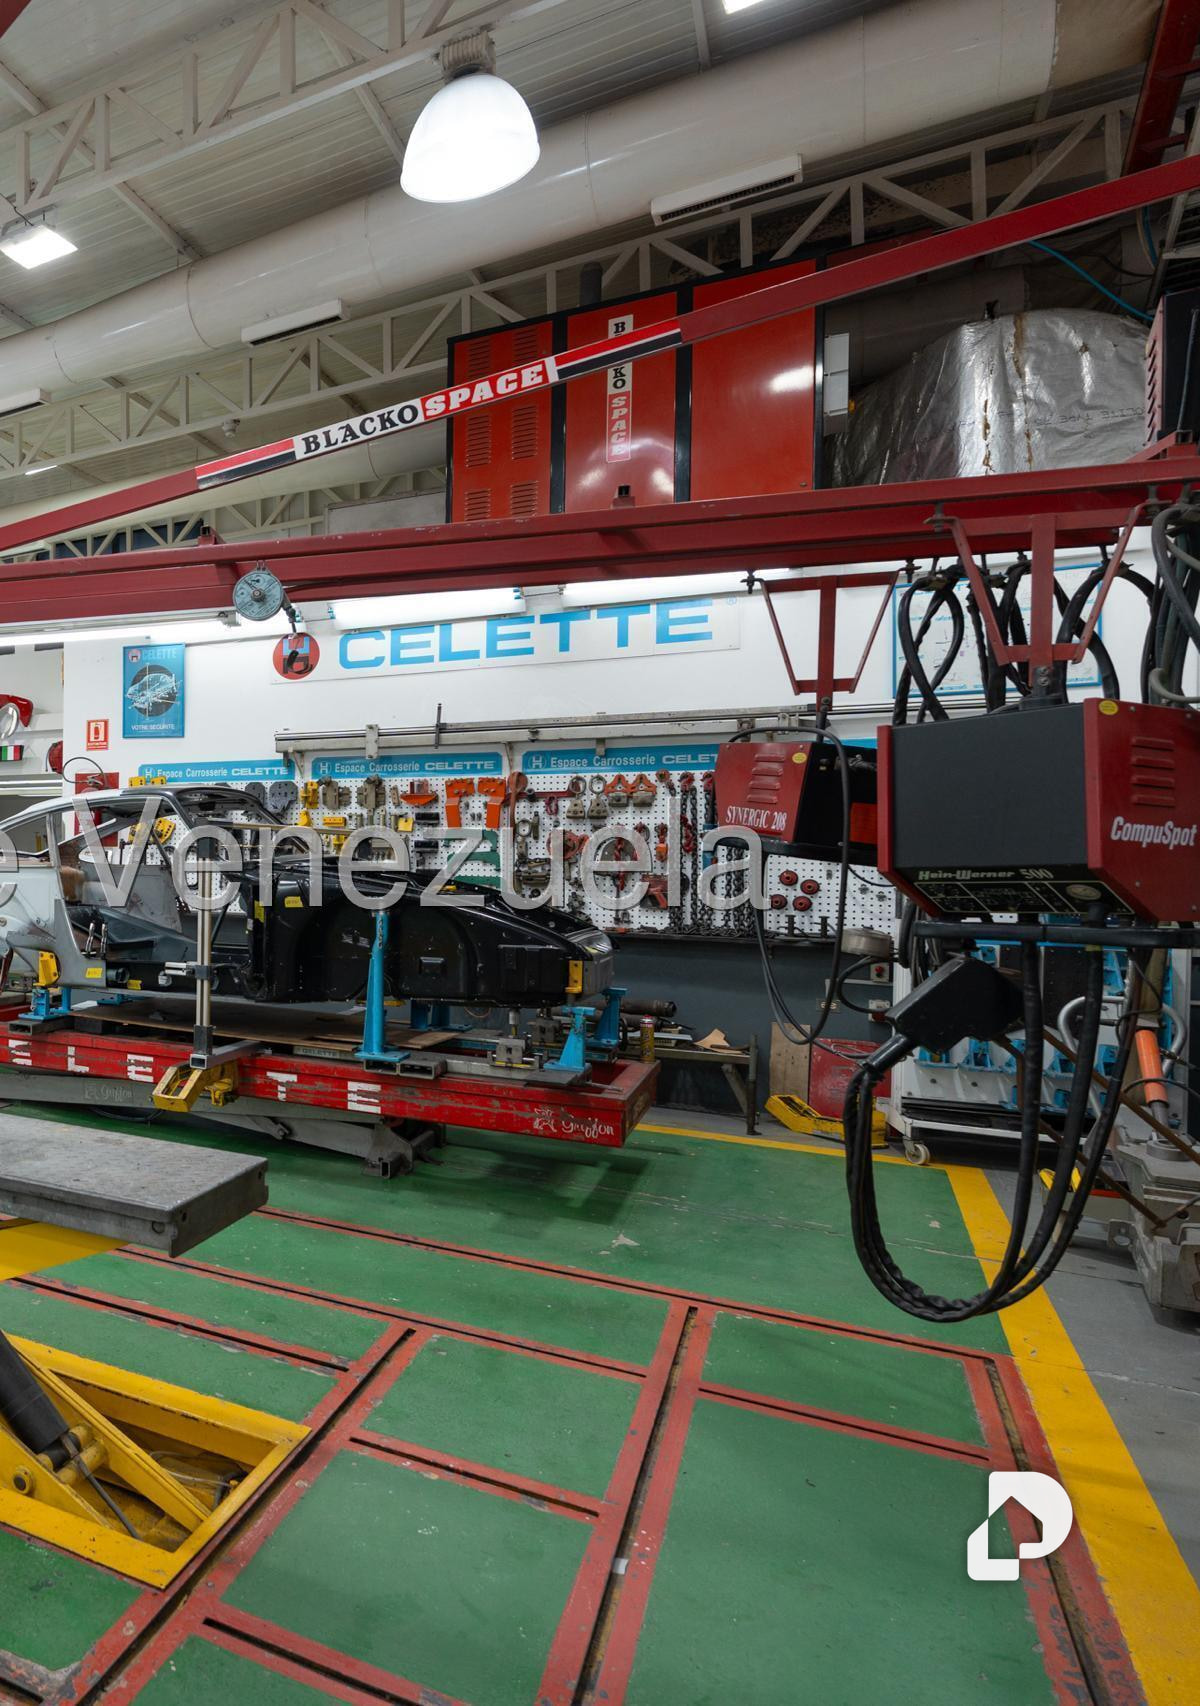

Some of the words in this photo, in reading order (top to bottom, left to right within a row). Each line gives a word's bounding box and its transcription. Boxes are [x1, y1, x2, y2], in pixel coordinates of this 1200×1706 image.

[339, 598, 713, 669] CELETTE
[335, 763, 365, 774] Espace
[369, 761, 420, 772] Carrosserie
[425, 761, 496, 771] CELETTE
[551, 757, 588, 769] Espace
[593, 755, 655, 767] Carrosserie
[662, 754, 718, 764] CELET
[185, 767, 228, 778] Carrosserie
[231, 767, 288, 776] CELETTE
[725, 805, 771, 829] SYNERGIC
[771, 811, 788, 831] 208
[1110, 816, 1197, 850] CompuSpot
[1019, 868, 1055, 880] 500
